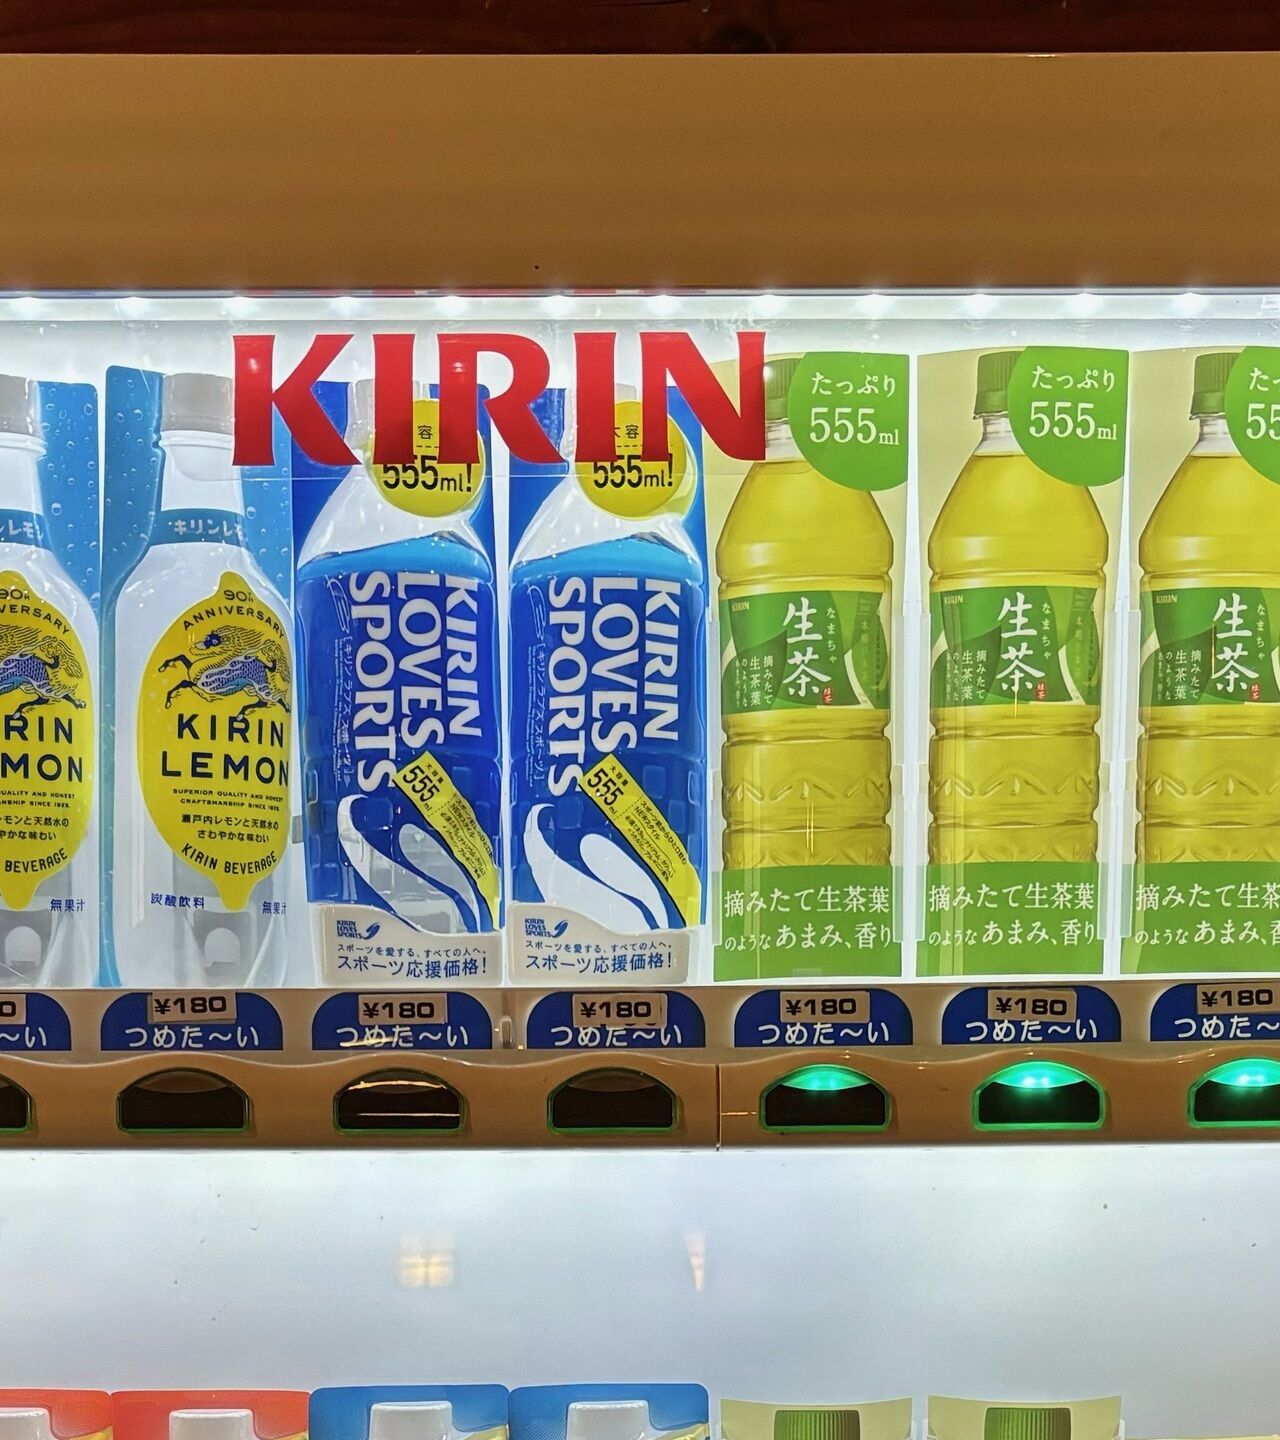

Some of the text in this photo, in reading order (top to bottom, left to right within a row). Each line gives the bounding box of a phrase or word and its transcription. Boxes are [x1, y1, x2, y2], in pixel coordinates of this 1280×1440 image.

[233, 332, 766, 466] KIRIN
[811, 372, 896, 395] たっぷり
[810, 407, 899, 445] 555ml
[182, 606, 285, 639] ANNIVERSARY
[398, 572, 444, 748] LOVES
[446, 575, 482, 737] KIRIN
[644, 578, 682, 741] KIRIN
[783, 596, 832, 698] 生茶
[996, 592, 1045, 692] 生茶
[1210, 593, 1260, 693] 生茶
[349, 571, 398, 792] SPORTS
[591, 577, 639, 752] LOVES
[547, 577, 588, 797] SPORTS
[177, 714, 285, 747] KIRIN
[161, 750, 289, 786] LEMON
[4, 847, 68, 874] BEVERAGE
[182, 843, 277, 875] KIRIN BEVERAGE
[724, 887, 890, 918] 摘みたて生茶葉
[154, 997, 226, 1014] ¥180
[363, 1003, 435, 1019] ¥180
[786, 999, 856, 1016] ¥180
[1202, 989, 1273, 1007] ¥180
